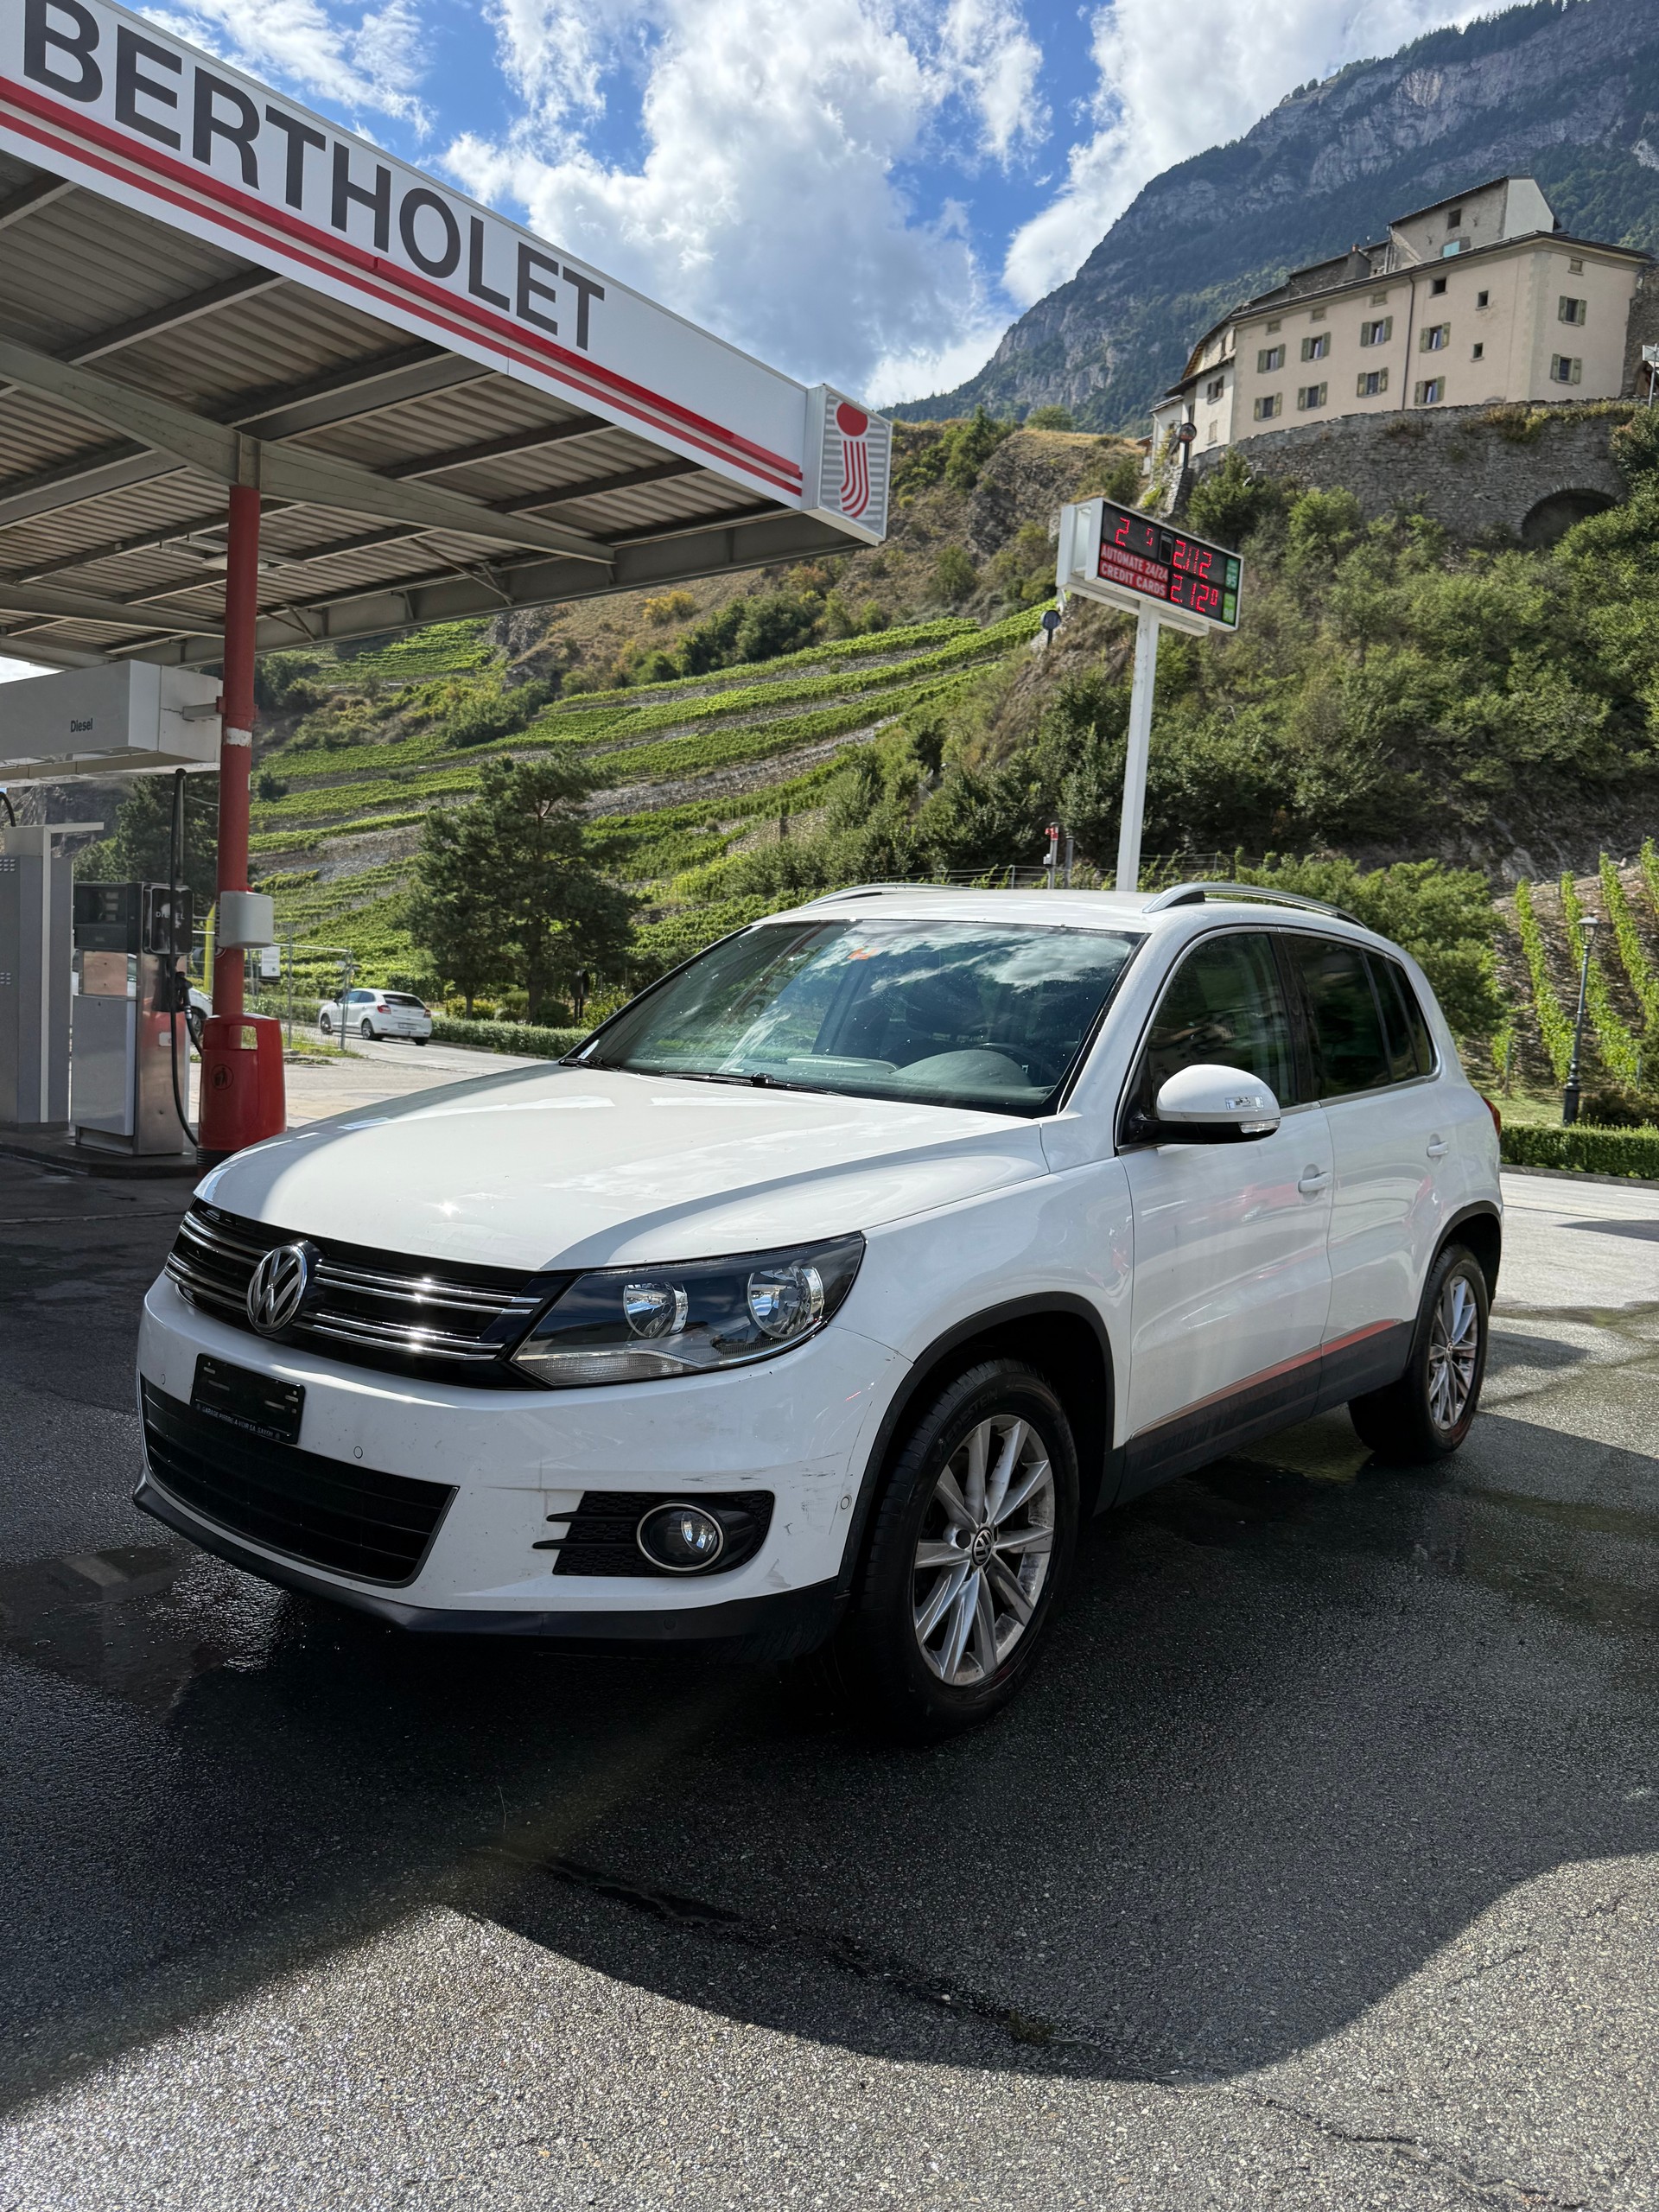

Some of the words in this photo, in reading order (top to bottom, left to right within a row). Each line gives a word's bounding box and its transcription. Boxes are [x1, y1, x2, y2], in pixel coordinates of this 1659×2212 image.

[24, 0, 605, 351] BERTHOLET
[1100, 544, 1143, 571] AUTOMATE
[1146, 562, 1168, 581] 24/24
[1101, 563, 1135, 584] CREDIT
[1136, 575, 1166, 596] CARDS
[1225, 574, 1237, 589] 95
[71, 718, 93, 733] Diesel
[156, 912, 185, 920] DIEEL
